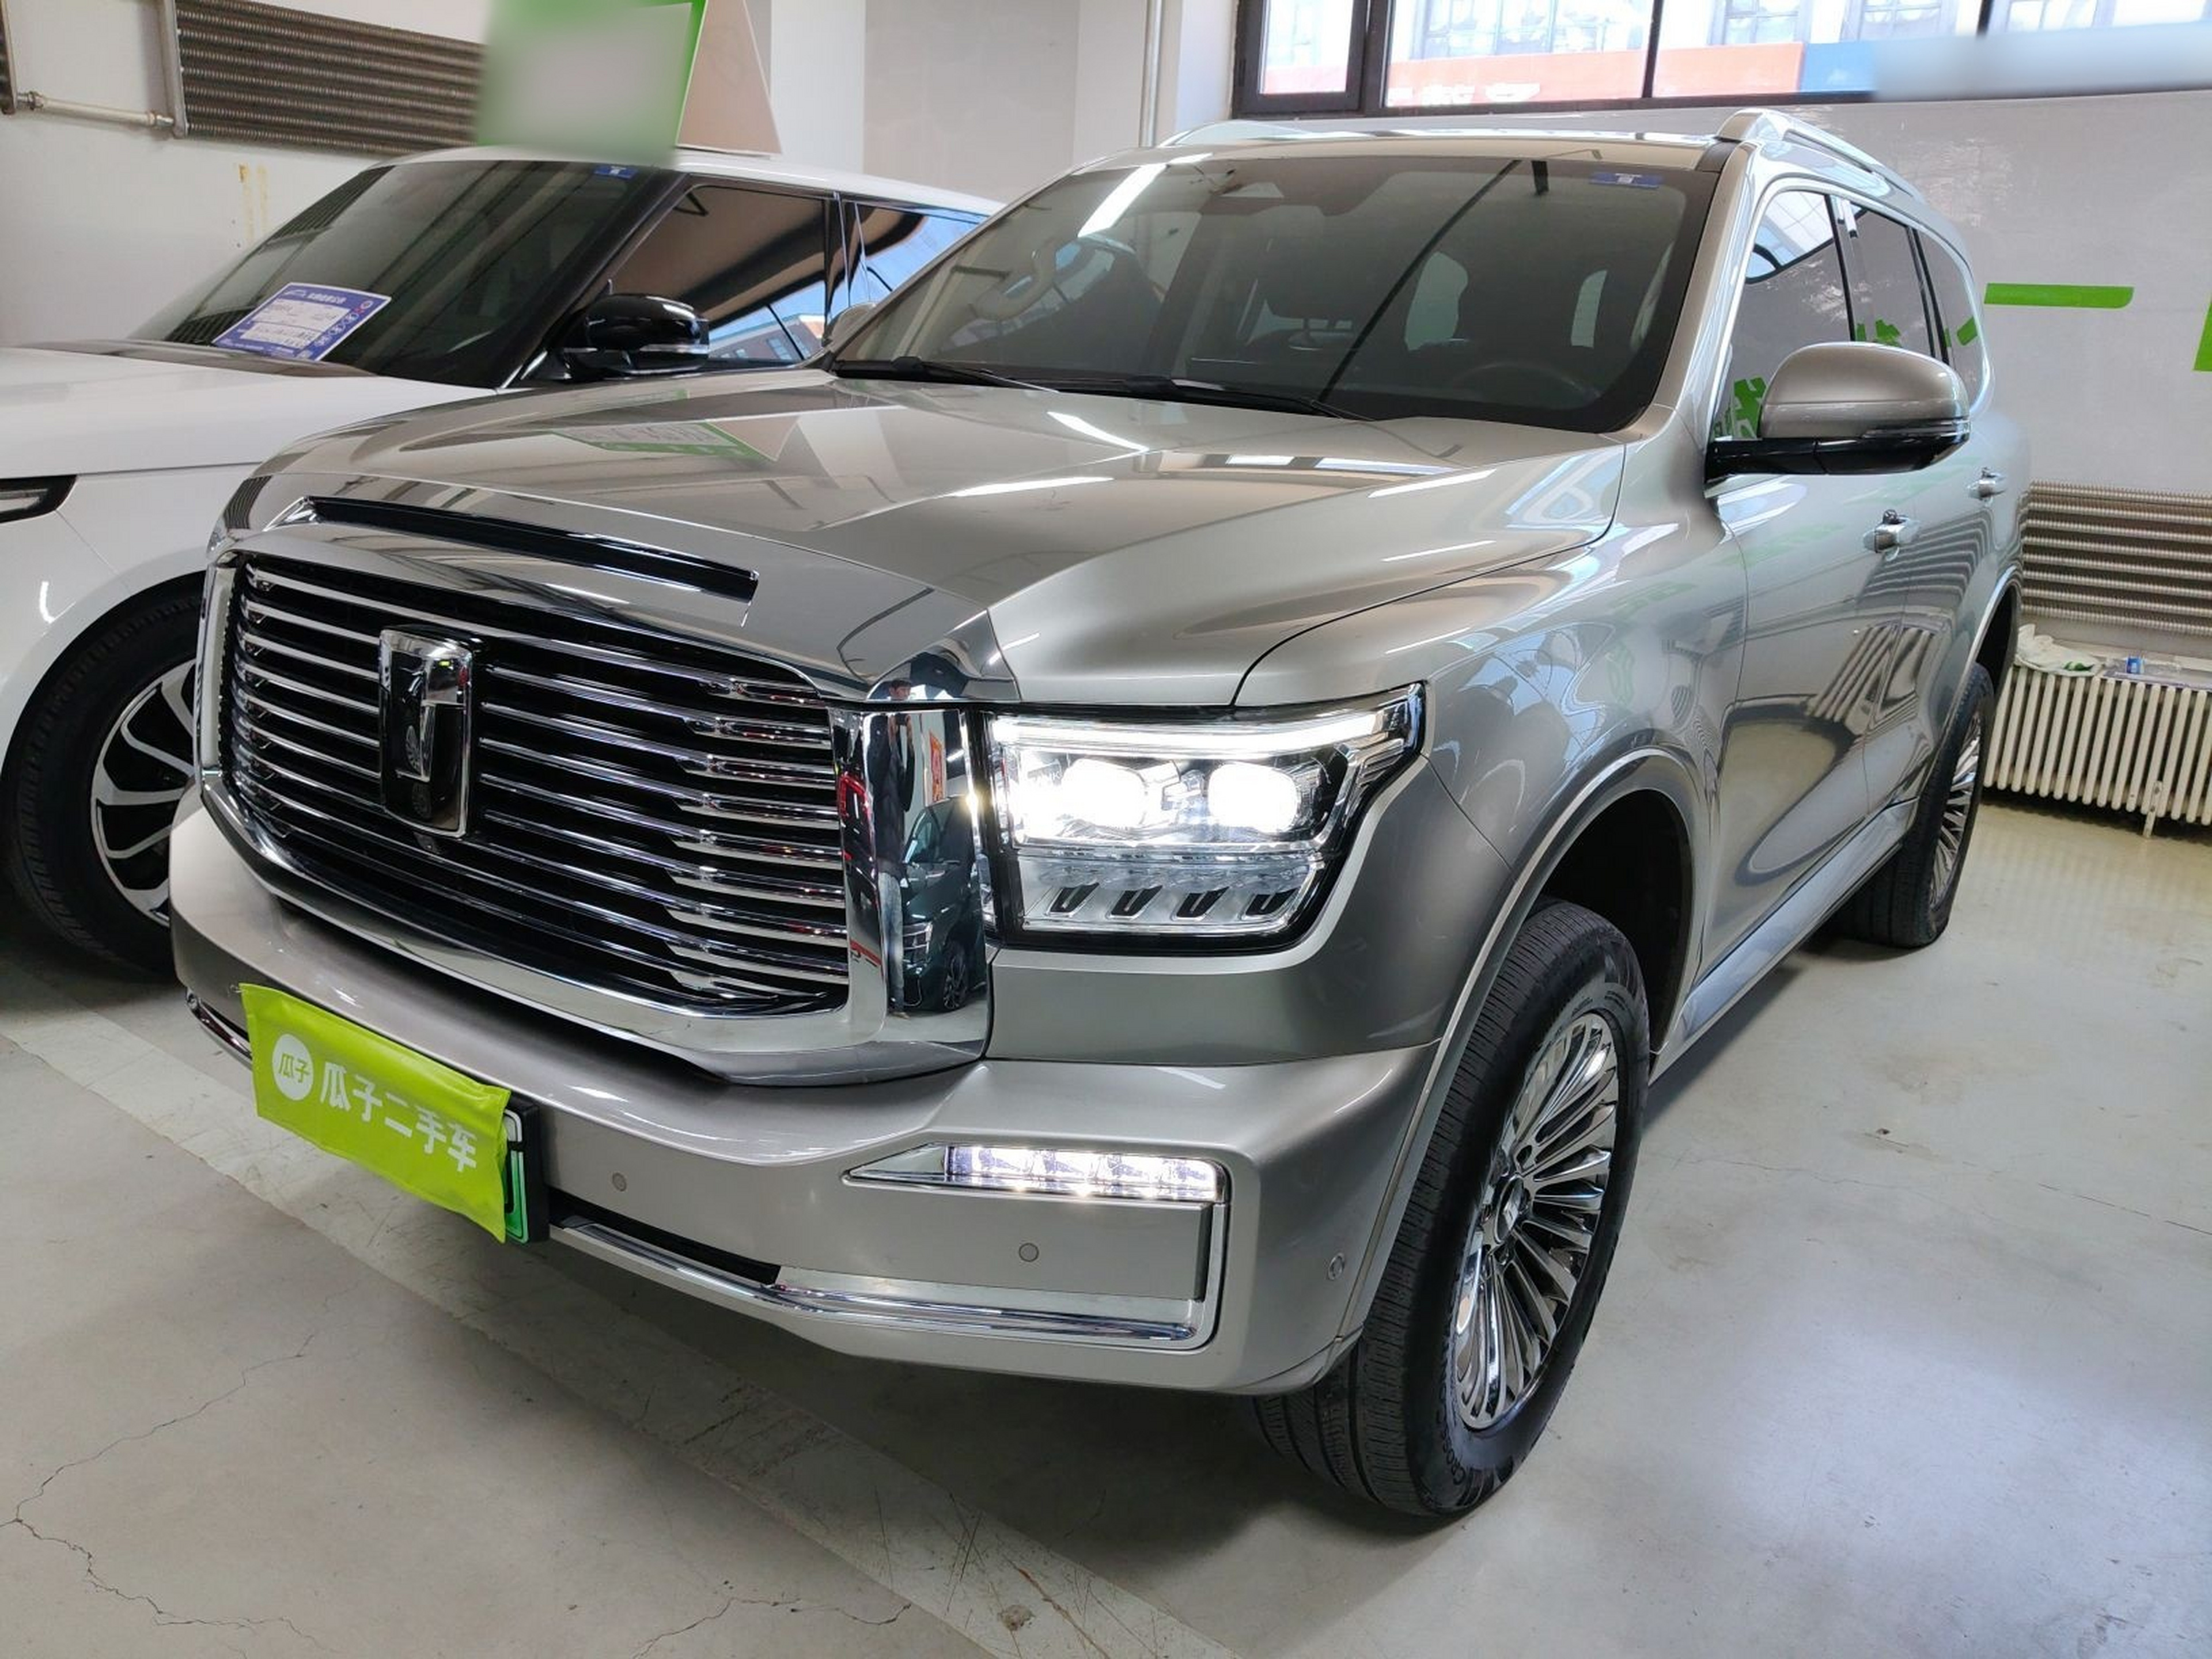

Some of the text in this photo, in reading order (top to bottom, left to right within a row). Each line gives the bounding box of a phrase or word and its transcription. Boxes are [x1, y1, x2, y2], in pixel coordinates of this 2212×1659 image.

[278, 1053, 310, 1083] 瓜子
[320, 1062, 477, 1172] 瓜子二手车
